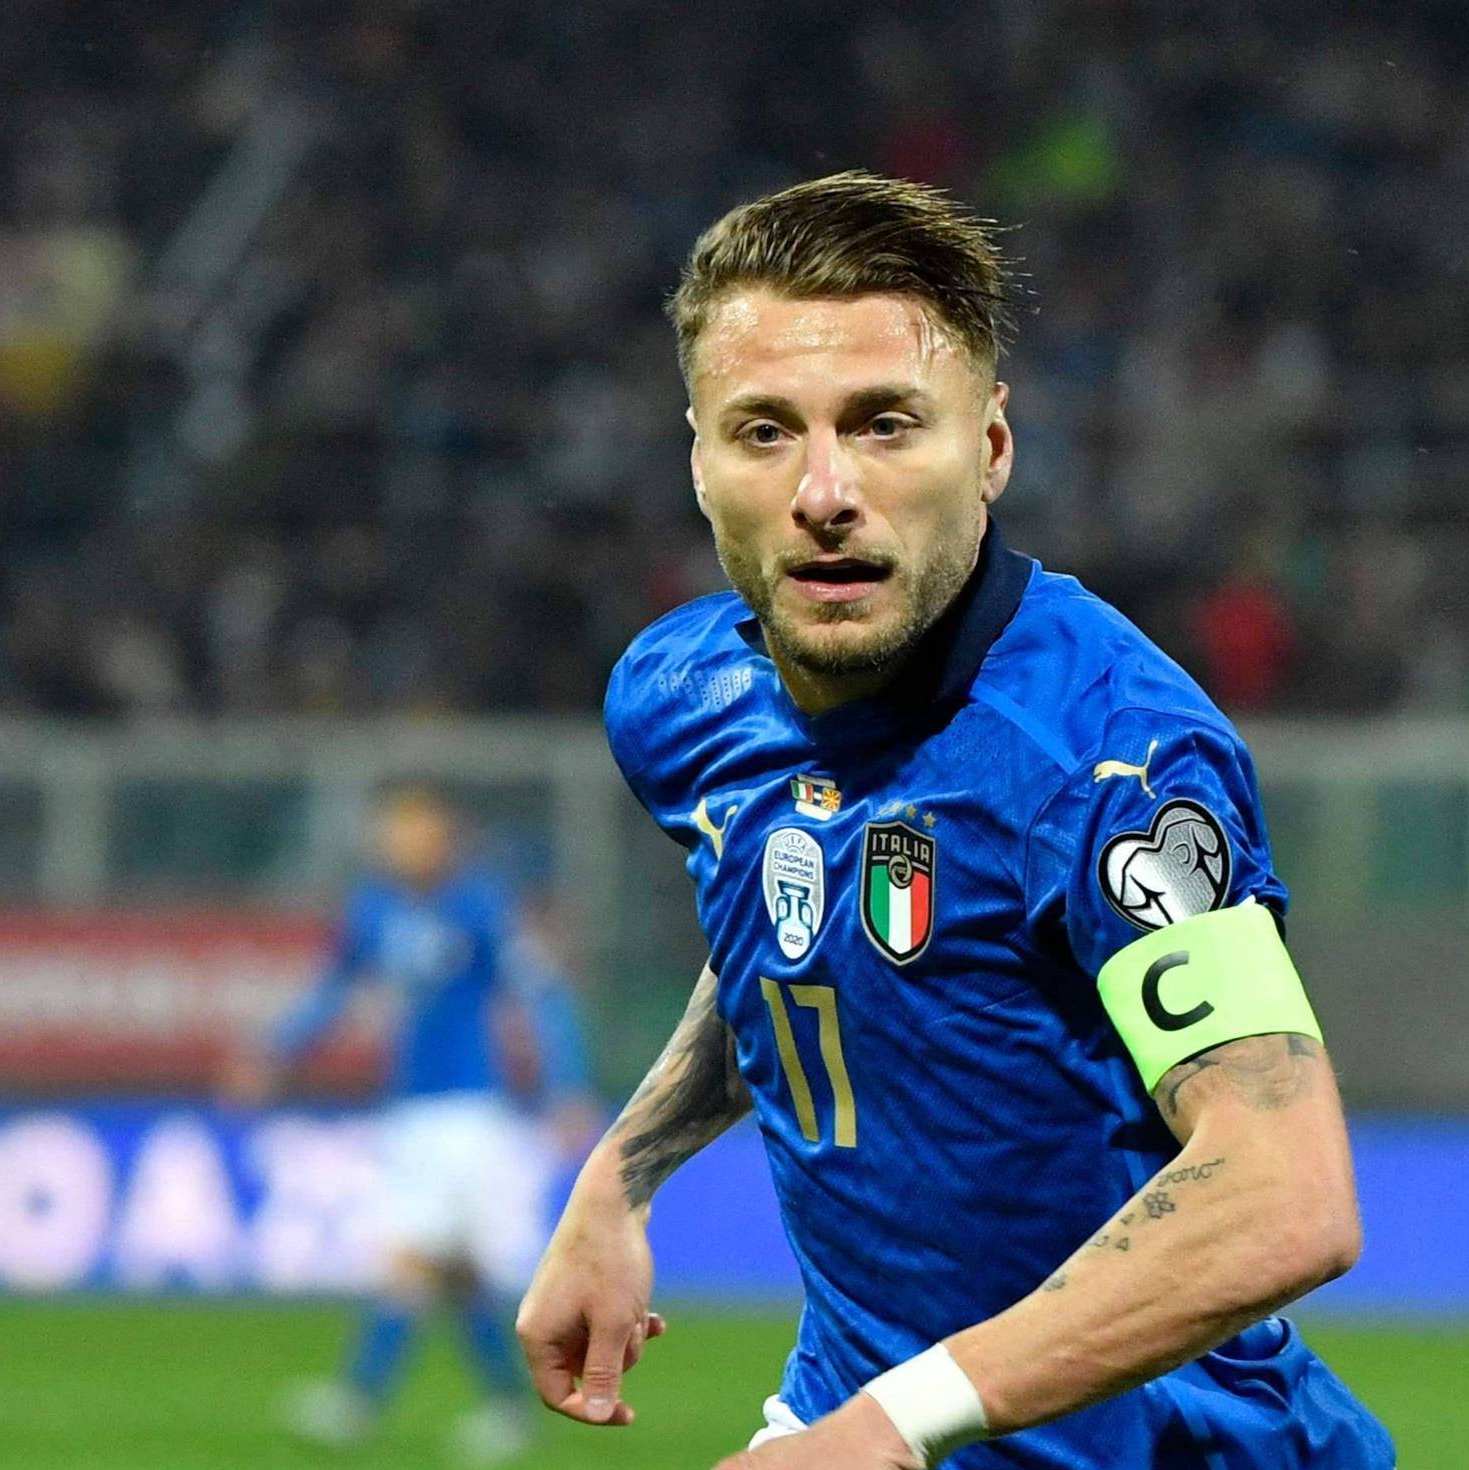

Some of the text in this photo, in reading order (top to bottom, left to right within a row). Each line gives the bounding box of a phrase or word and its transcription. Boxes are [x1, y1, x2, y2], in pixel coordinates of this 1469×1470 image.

[774, 850, 814, 868] EUROPEAN
[872, 833, 930, 863] ITALIA
[773, 861, 814, 879] CHAMPIONS
[784, 932, 803, 946] 2020
[1141, 950, 1215, 1031] C
[759, 975, 857, 1148] 17
[120, 1113, 234, 1292] A
